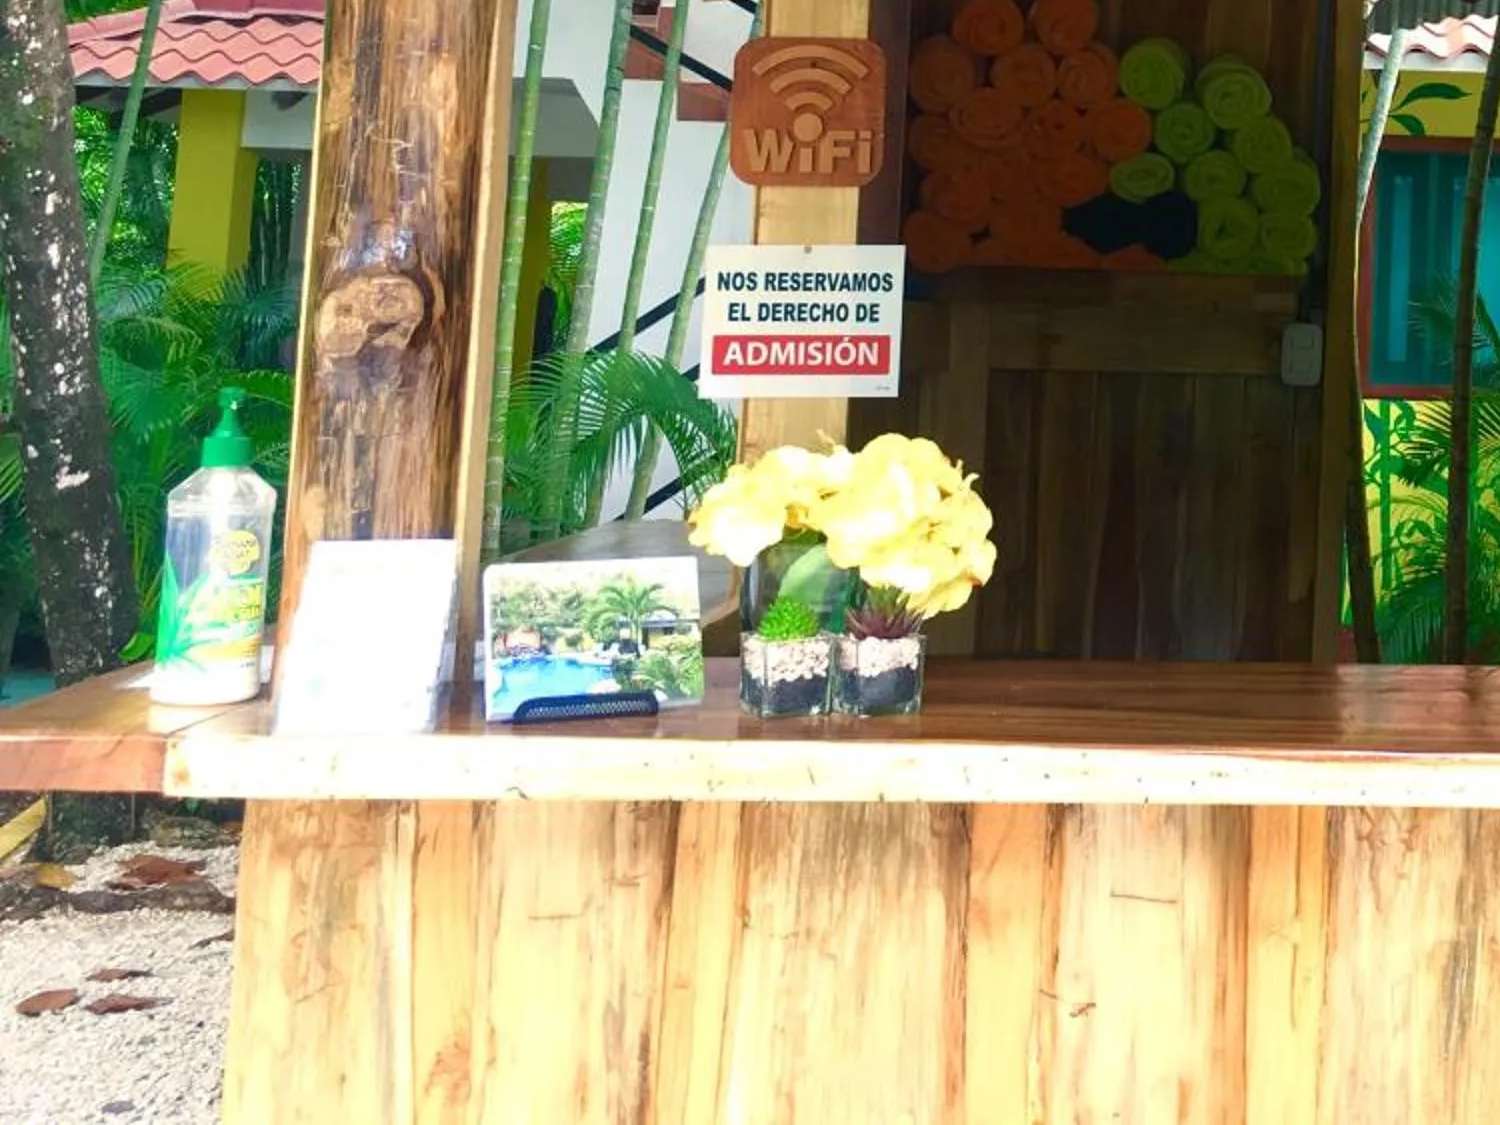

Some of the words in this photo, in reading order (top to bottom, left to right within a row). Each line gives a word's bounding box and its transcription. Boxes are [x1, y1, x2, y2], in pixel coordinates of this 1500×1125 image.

[744, 125, 872, 174] WiFi
[716, 272, 757, 292] NOS
[764, 272, 894, 293] RESERVAMOS
[727, 303, 751, 323] EL
[757, 303, 849, 323] DERECHO
[856, 303, 880, 323] DE
[723, 336, 879, 367] ADMISIÓN
